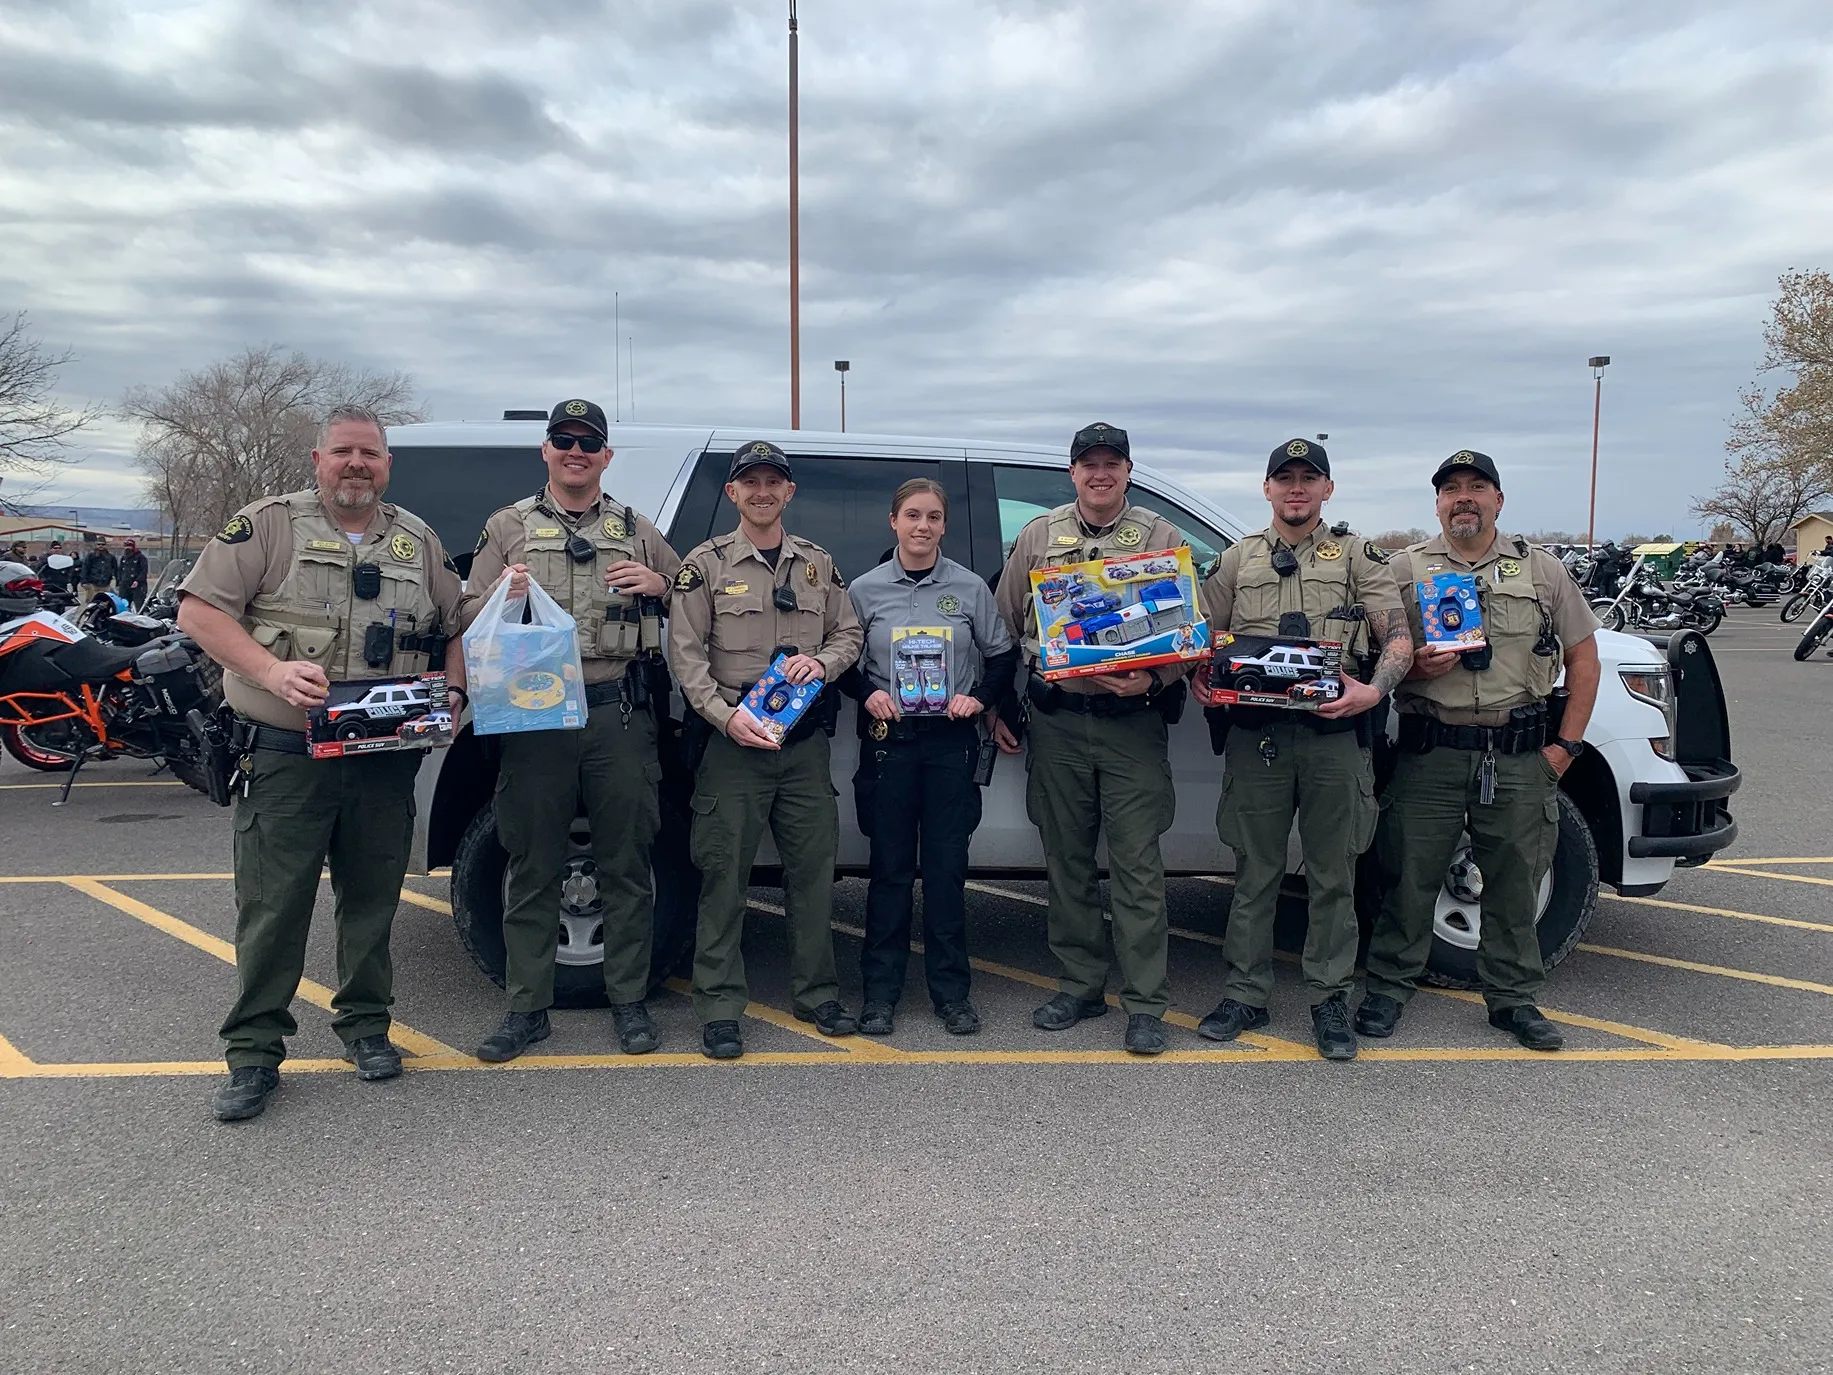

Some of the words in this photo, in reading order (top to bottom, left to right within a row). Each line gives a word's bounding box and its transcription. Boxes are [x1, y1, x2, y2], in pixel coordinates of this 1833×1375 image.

[1264, 665, 1299, 678] POLICE
[161, 688, 178, 714] MOSKO
[365, 704, 407, 718] POLICE
[357, 742, 375, 750] POLICE
